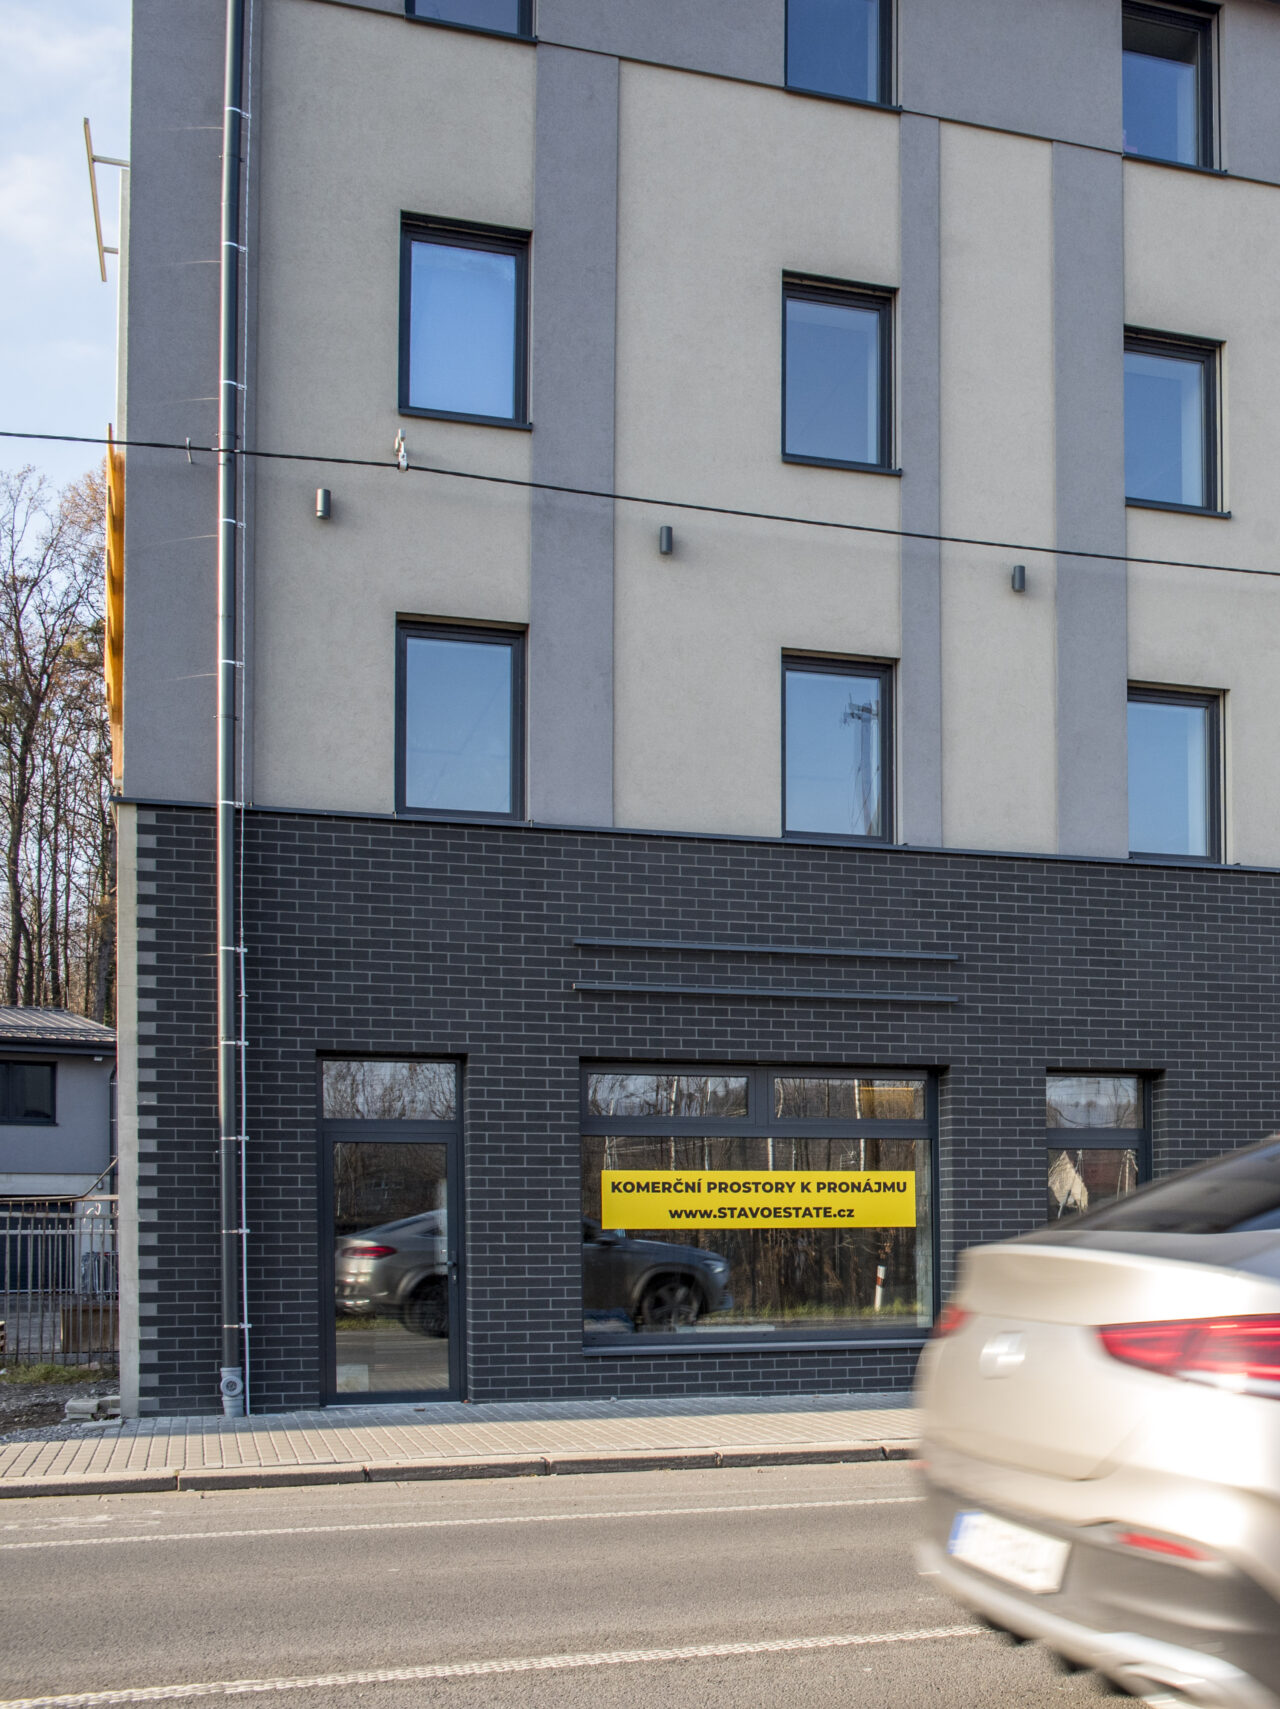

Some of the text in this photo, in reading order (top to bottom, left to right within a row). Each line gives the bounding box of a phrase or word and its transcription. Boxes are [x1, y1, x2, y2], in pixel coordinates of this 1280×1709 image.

[611, 1178, 907, 1194] KOMERČNÍ PROSTORY K PRONÁJMU
[668, 1206, 855, 1219] www.STAVOESTATE.cz
